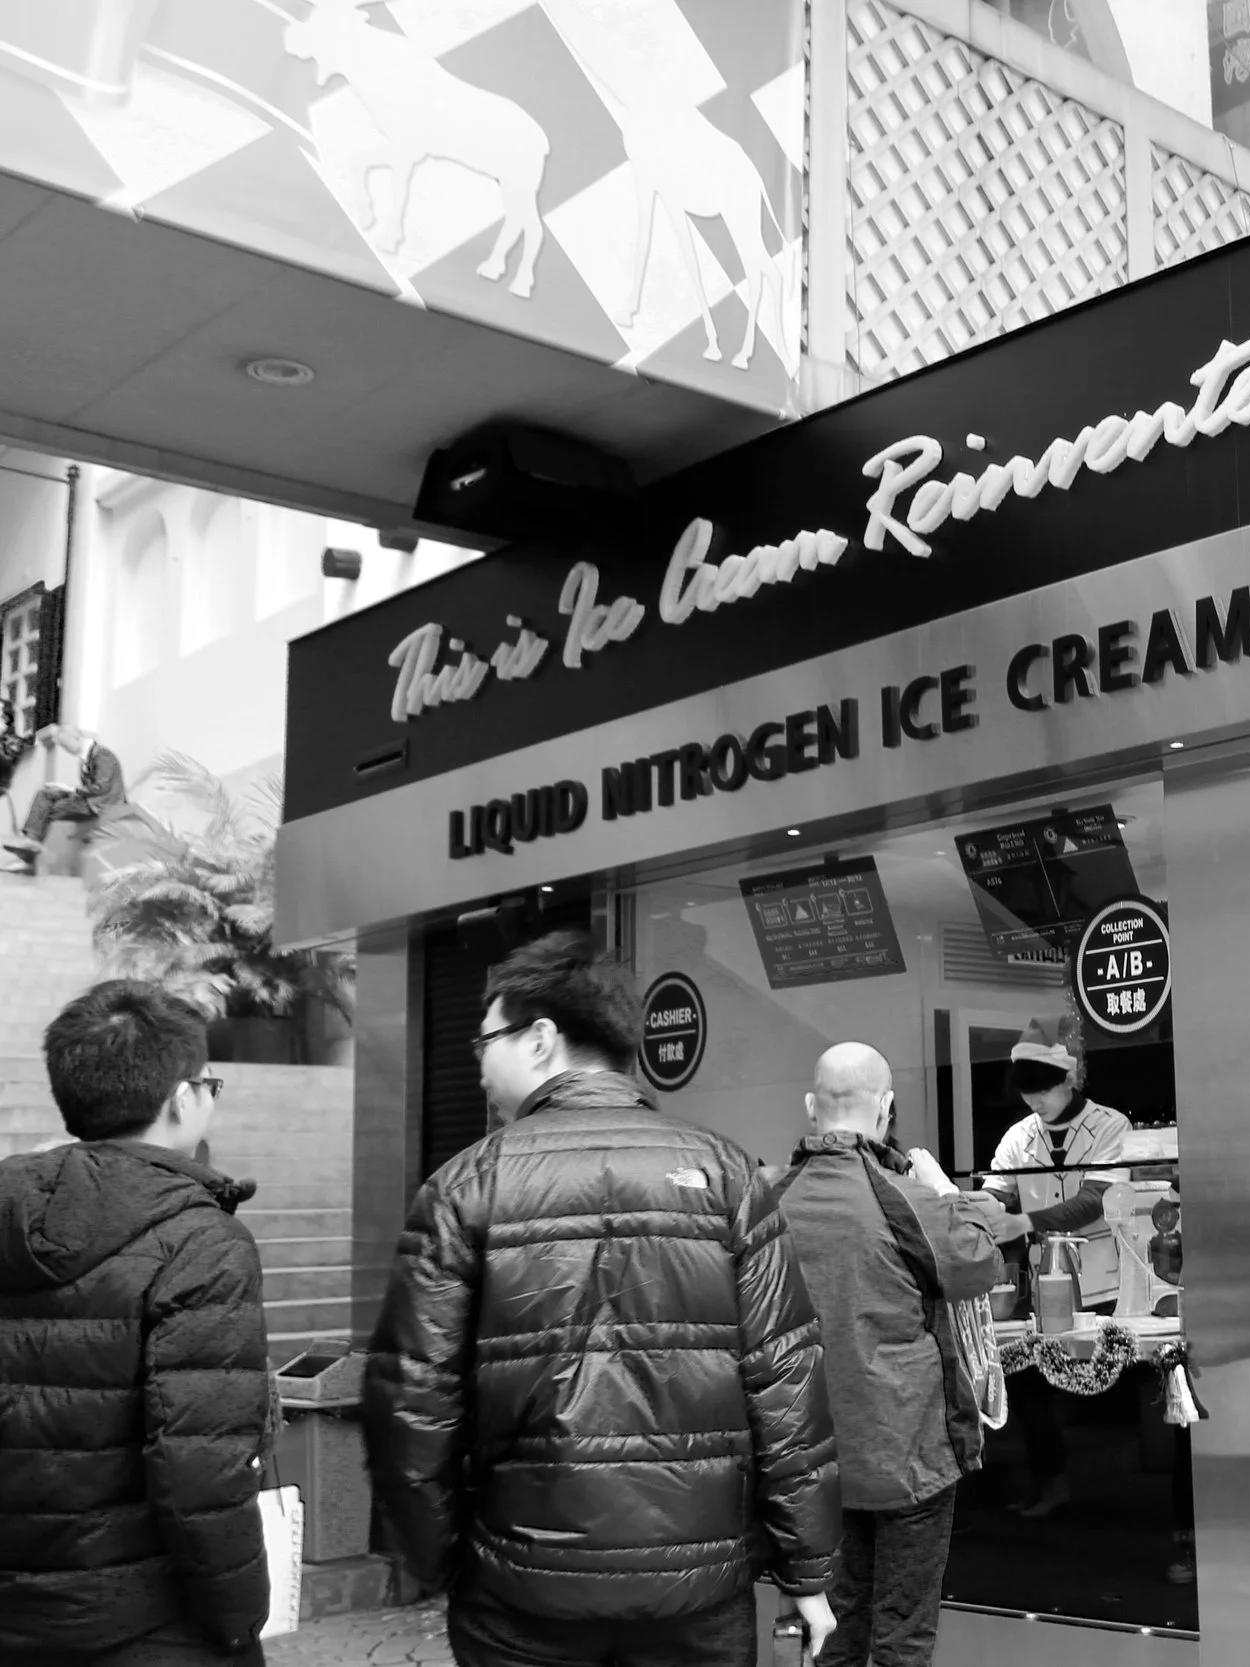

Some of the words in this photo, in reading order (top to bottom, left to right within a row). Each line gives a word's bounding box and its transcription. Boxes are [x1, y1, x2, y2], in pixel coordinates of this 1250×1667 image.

[388, 622, 488, 722] This
[491, 614, 549, 680] is
[559, 561, 645, 668] Ice
[659, 518, 849, 624] Cream
[448, 779, 589, 861] LIQUID
[601, 696, 860, 821] NITROGEN
[880, 664, 981, 750] ICE
[1101, 918, 1143, 934] COLLECTION
[1113, 931, 1133, 944] POINT
[1106, 988, 1146, 1016] 取餐處
